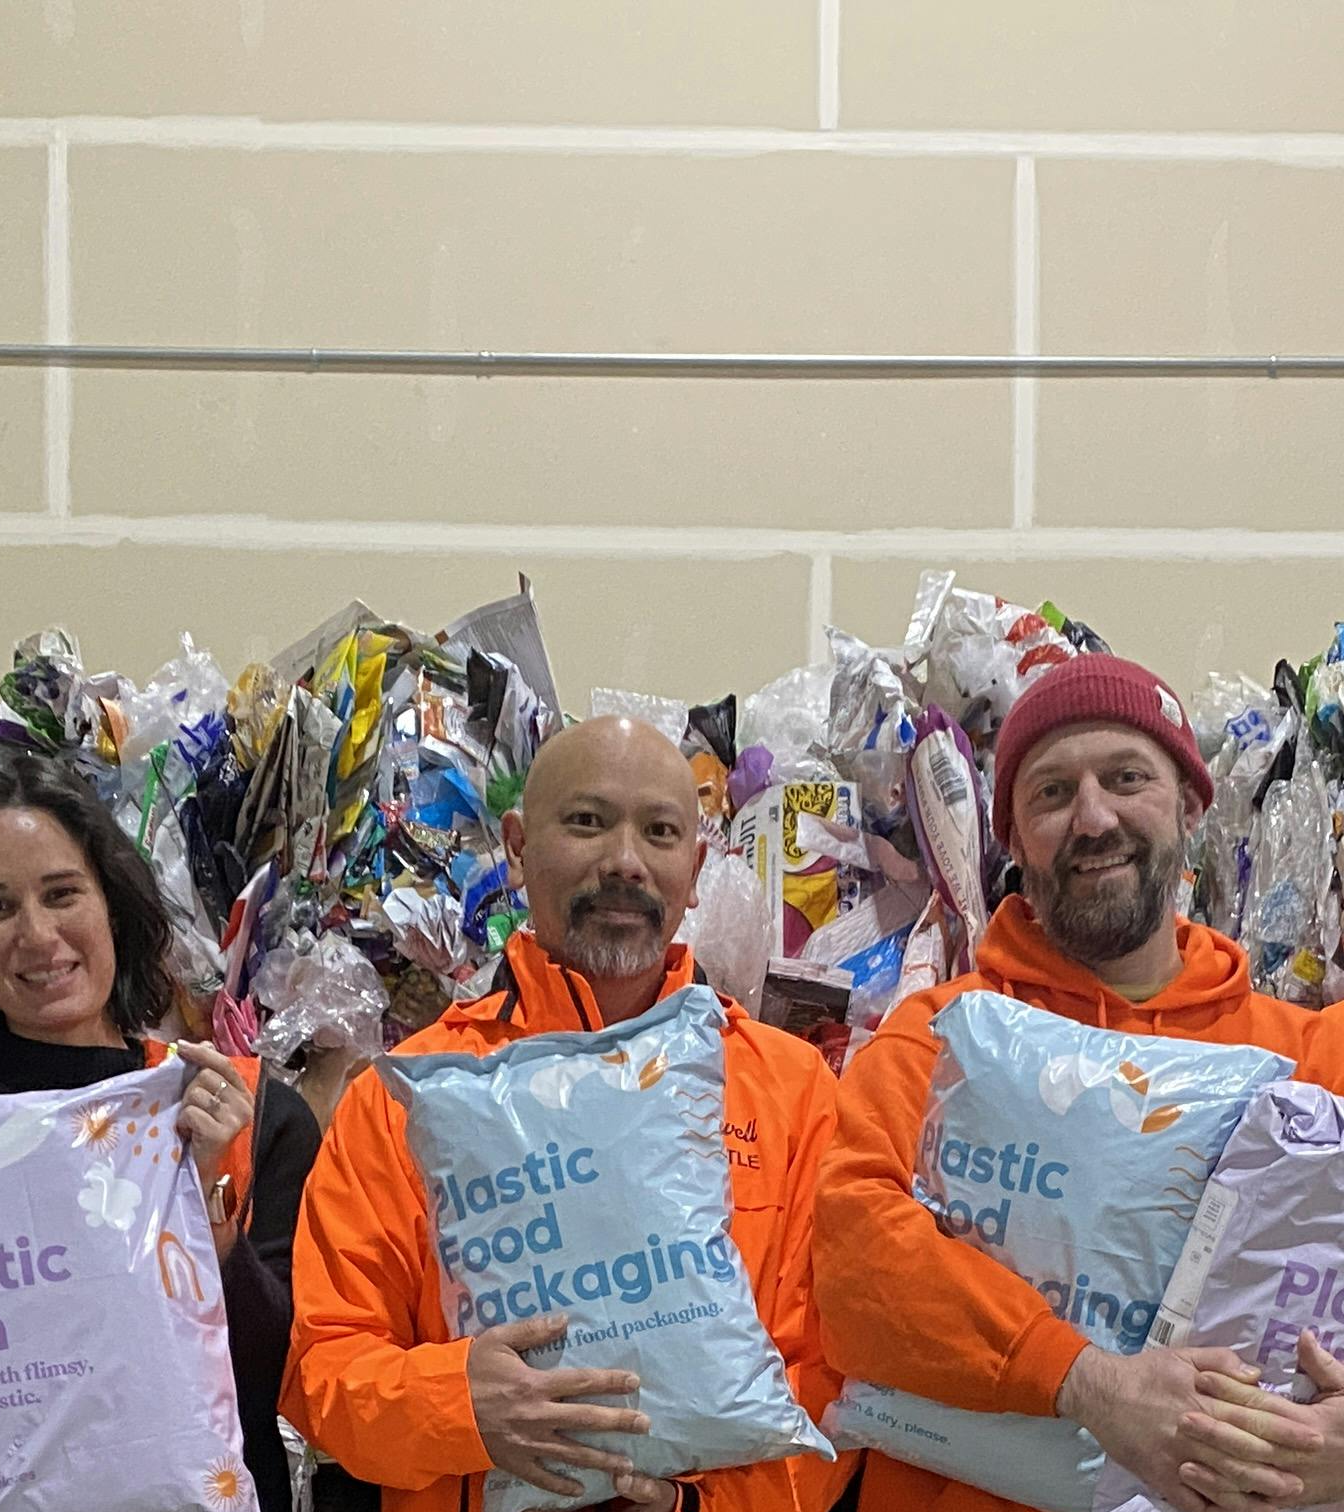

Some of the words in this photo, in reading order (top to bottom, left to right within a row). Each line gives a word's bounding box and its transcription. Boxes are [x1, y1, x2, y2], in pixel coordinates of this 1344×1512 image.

[721, 1119, 757, 1142] well
[922, 1119, 1070, 1199] Plastic
[438, 1202, 563, 1284] Food
[457, 1233, 736, 1338] Packaging
[574, 1321, 619, 1347] food
[622, 1302, 724, 1340] packaging.
[24, 1359, 94, 1382] flimsy,
[864, 1406, 874, 1417] &
[904, 1423, 951, 1446] please.
